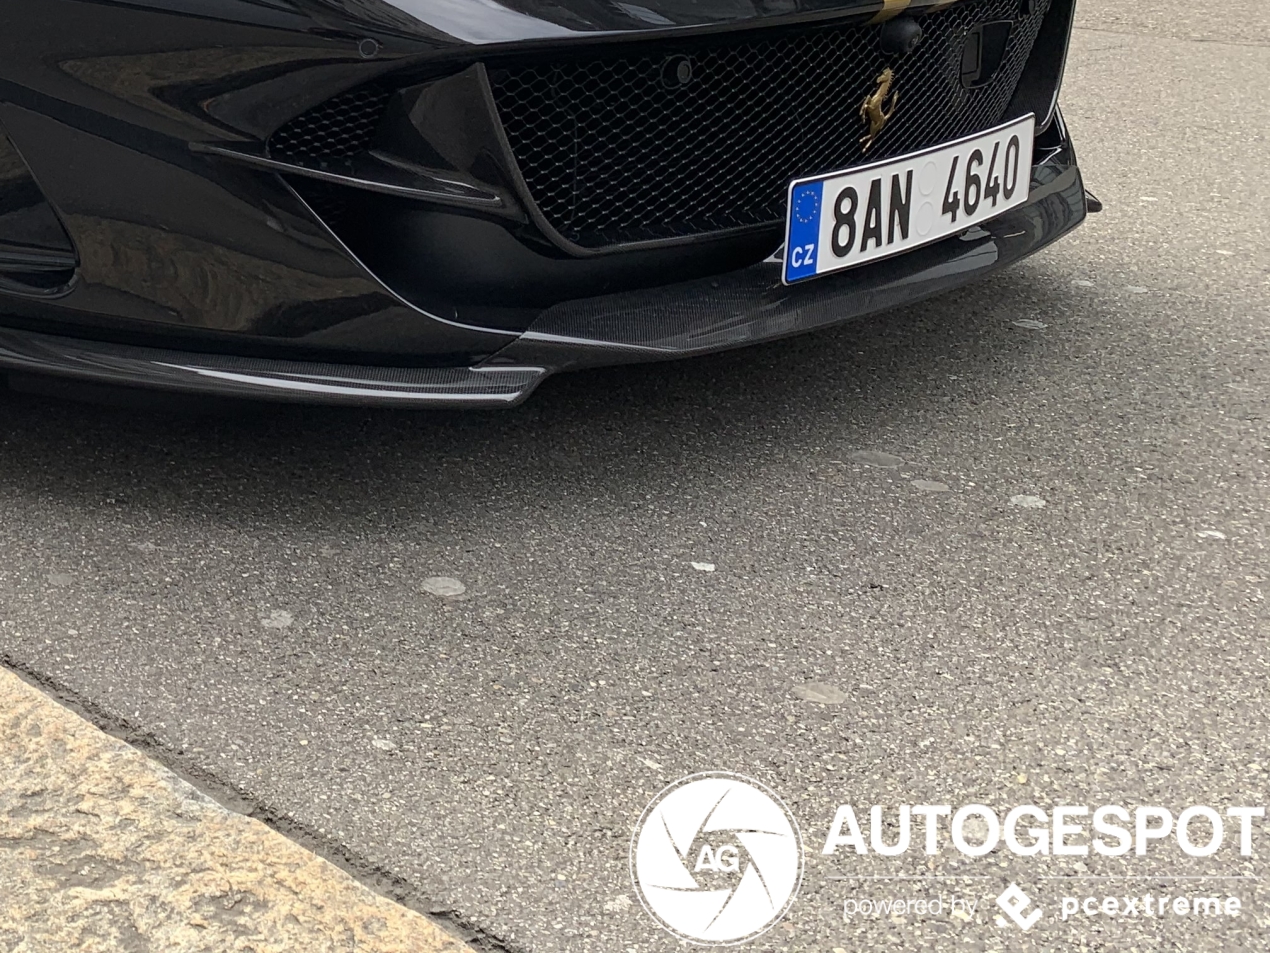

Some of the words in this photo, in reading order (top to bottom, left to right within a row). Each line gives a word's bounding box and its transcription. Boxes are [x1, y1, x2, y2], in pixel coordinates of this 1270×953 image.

[831, 169, 913, 258] 8AN
[941, 134, 1020, 223] 4640
[791, 243, 815, 268] CZ
